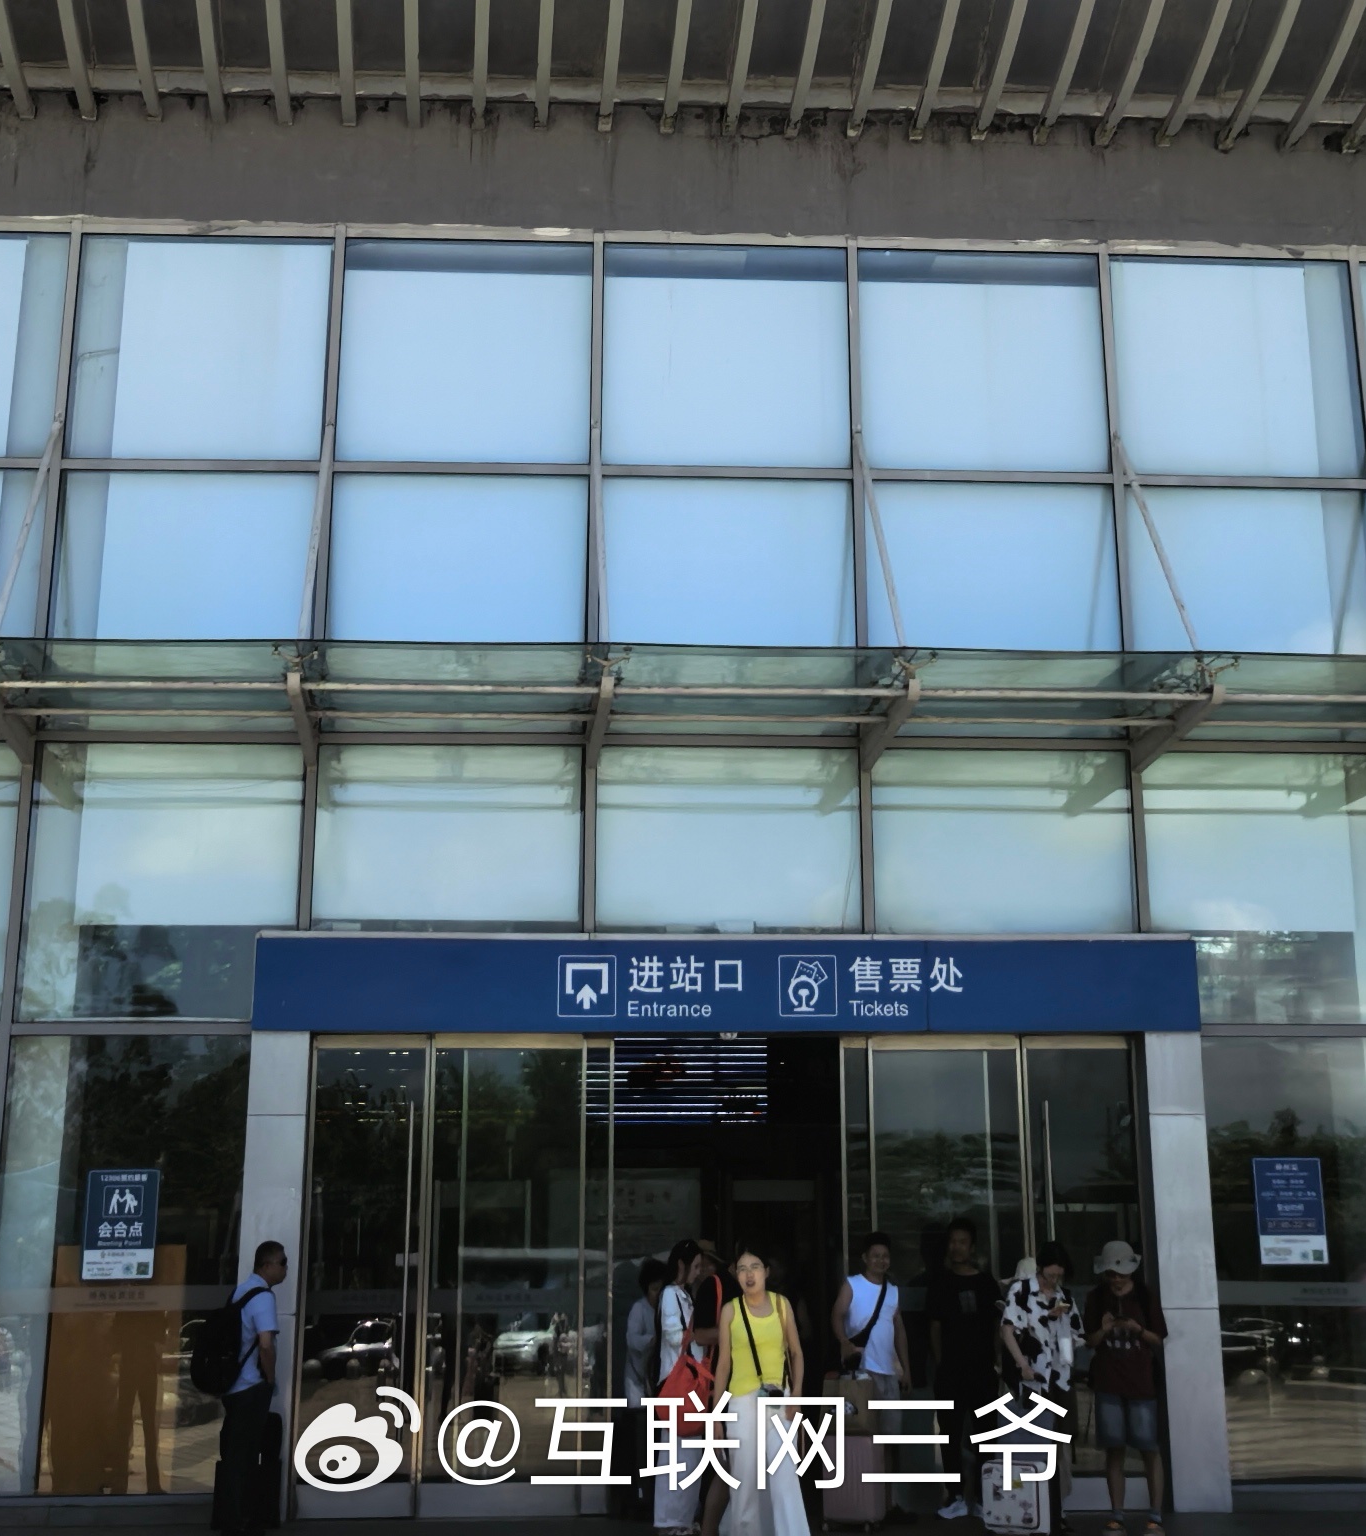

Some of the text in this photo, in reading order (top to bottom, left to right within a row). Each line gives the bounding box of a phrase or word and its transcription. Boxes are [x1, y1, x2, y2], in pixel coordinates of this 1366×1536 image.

[628, 955, 743, 993] 进站口
[848, 956, 963, 993] 售票处
[627, 1000, 712, 1017] Entrance
[848, 1000, 909, 1017] Tickets
[98, 1221, 143, 1238] 会合点
